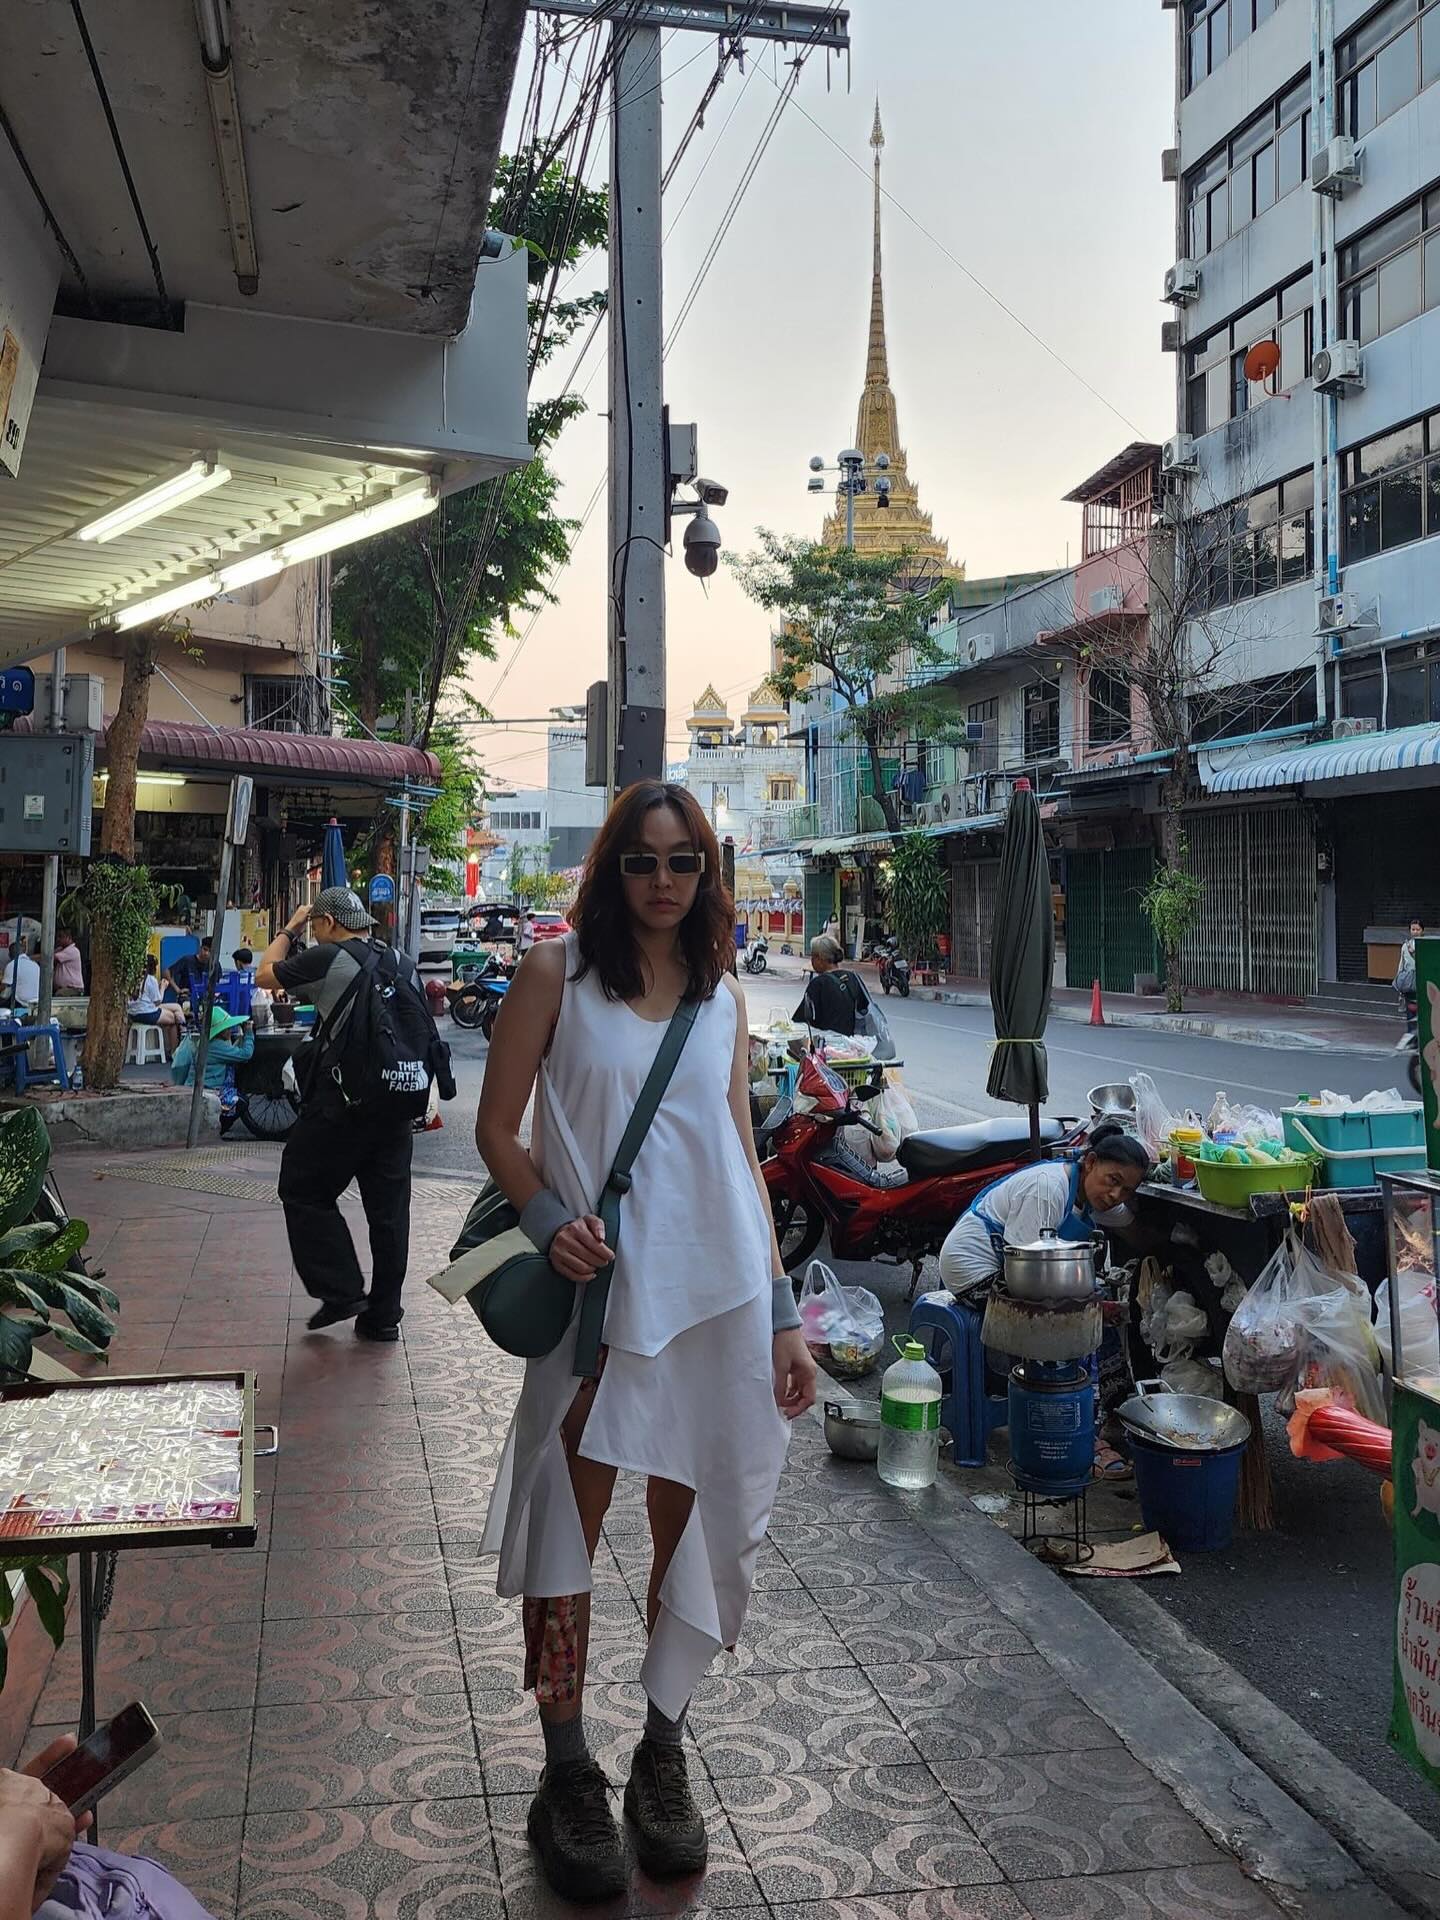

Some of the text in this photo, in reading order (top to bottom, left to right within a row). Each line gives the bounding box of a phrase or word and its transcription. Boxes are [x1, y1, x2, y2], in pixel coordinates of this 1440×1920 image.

[397, 1061, 419, 1071] THE
[381, 1068, 418, 1081] NORTH
[389, 1081, 417, 1091] FACE
